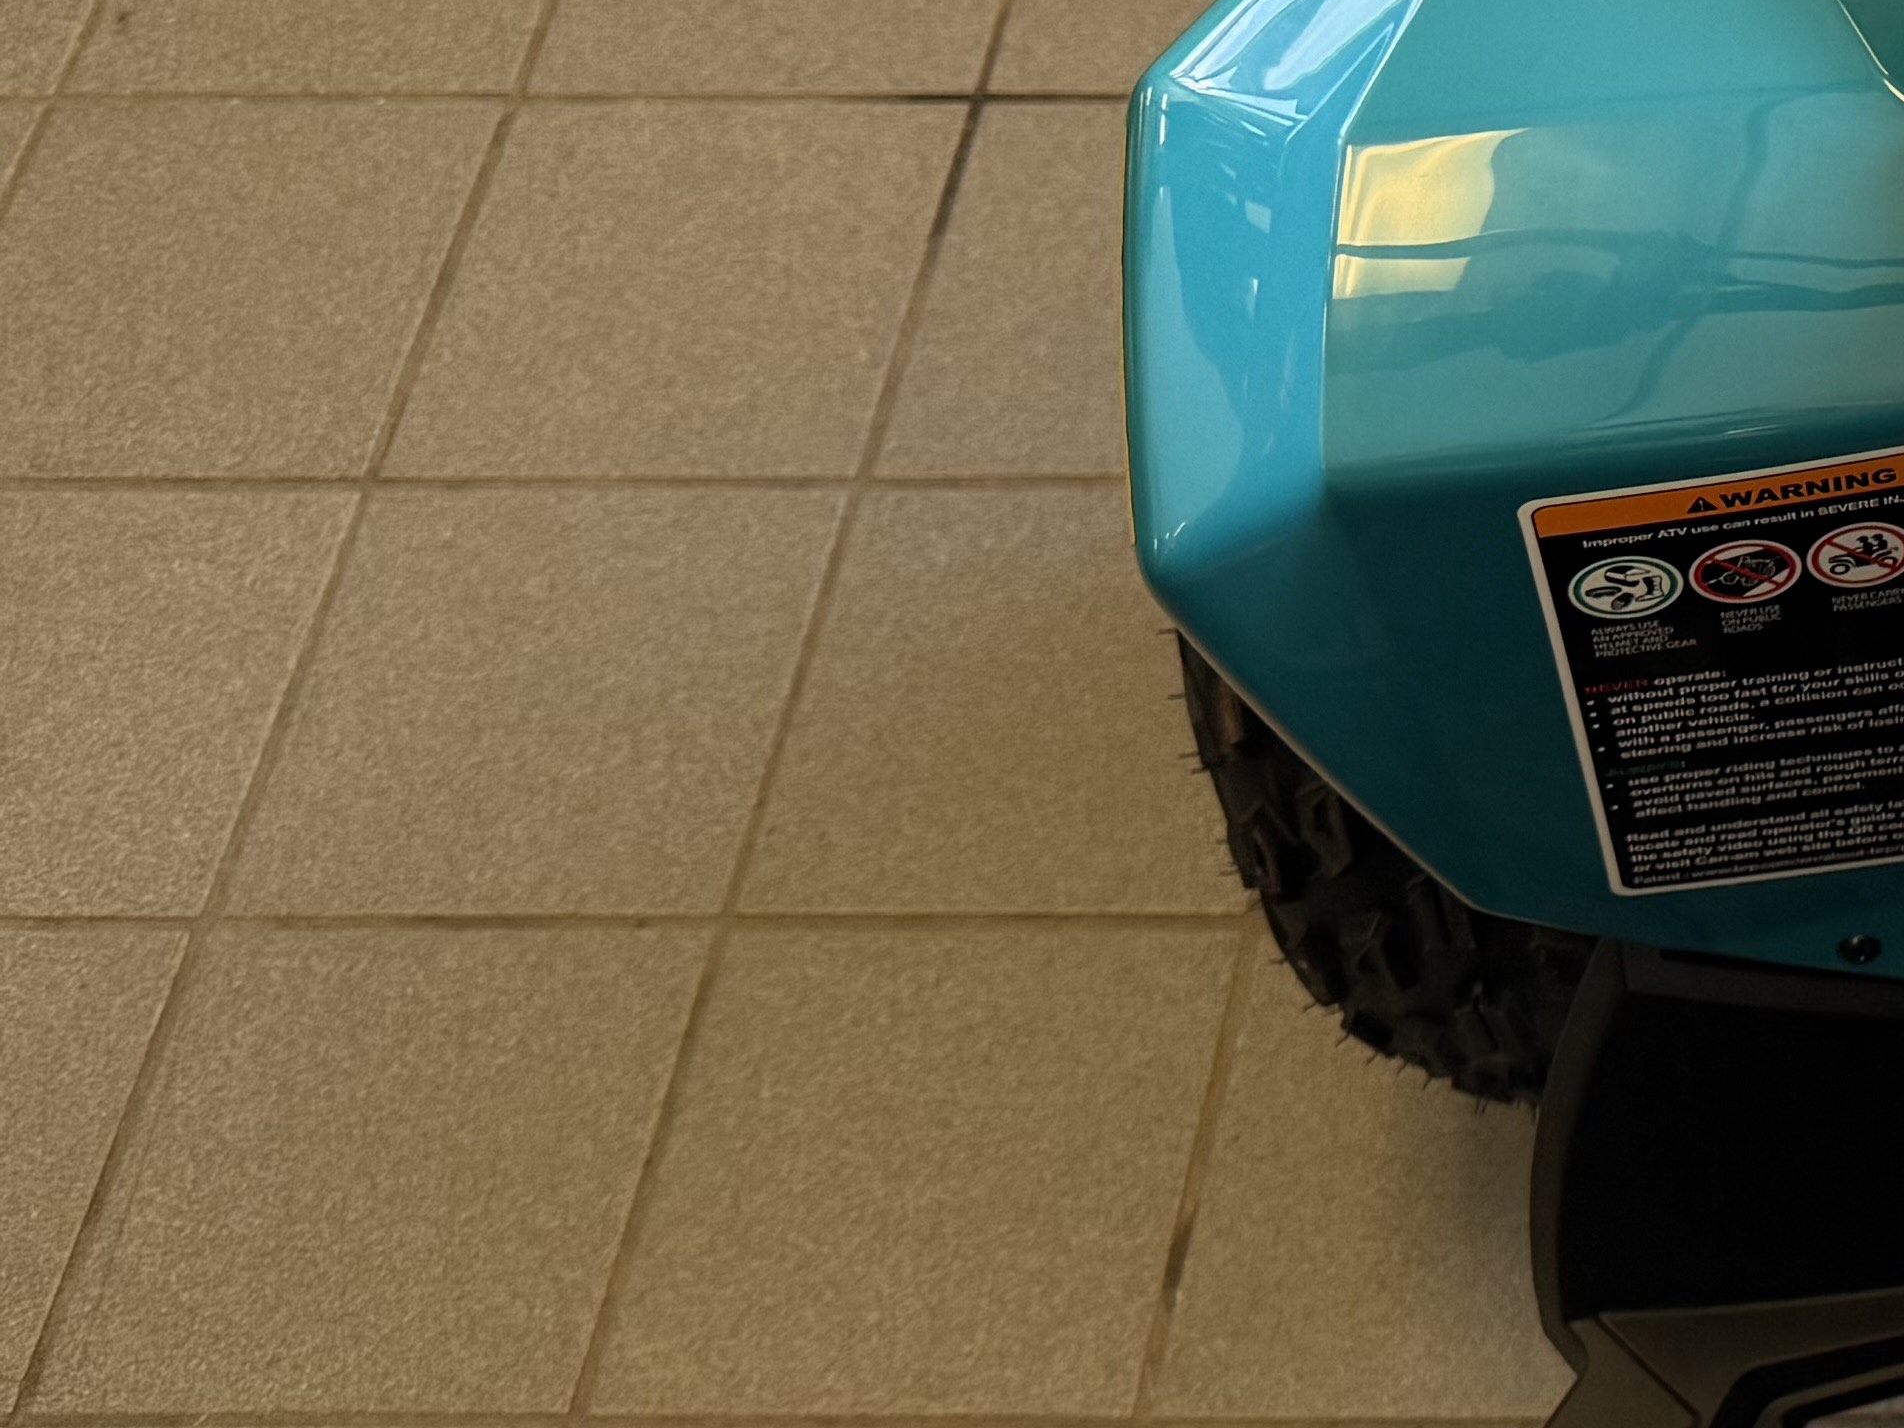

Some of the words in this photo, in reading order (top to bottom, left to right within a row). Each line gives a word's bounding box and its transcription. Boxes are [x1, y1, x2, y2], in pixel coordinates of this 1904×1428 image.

[1718, 466, 1898, 509] WARNING
[1581, 531, 1654, 549] Improper
[1656, 525, 1688, 539] ATV
[1689, 523, 1720, 535] use
[1721, 518, 1752, 531] can
[1752, 510, 1797, 526] result
[1799, 509, 1815, 519] in
[1816, 496, 1880, 517] SEVERE
[1606, 686, 1675, 704] without
[1678, 679, 1737, 696] proper
[1740, 670, 1810, 687] training
[1812, 667, 1832, 678] or
[1609, 704, 1628, 716] at
[1631, 695, 1697, 713] speeds
[1699, 692, 1731, 704] too
[1732, 685, 1768, 700] fast
[1770, 682, 1796, 694] for
[1799, 677, 1841, 693] your
[1843, 670, 1890, 686] skills
[1652, 669, 1727, 687] operate:
[1611, 715, 1637, 727] on
[1639, 706, 1696, 725] public
[1773, 688, 1849, 706] collision
[1851, 683, 1884, 697] can
[1614, 720, 1683, 738] another
[1686, 711, 1756, 728] vehicle.
[1619, 742, 1693, 760] steering
[1694, 735, 1730, 750] and
[1732, 727, 1807, 745] increase
[1809, 722, 1843, 735] risk
[1846, 718, 1865, 731] of
